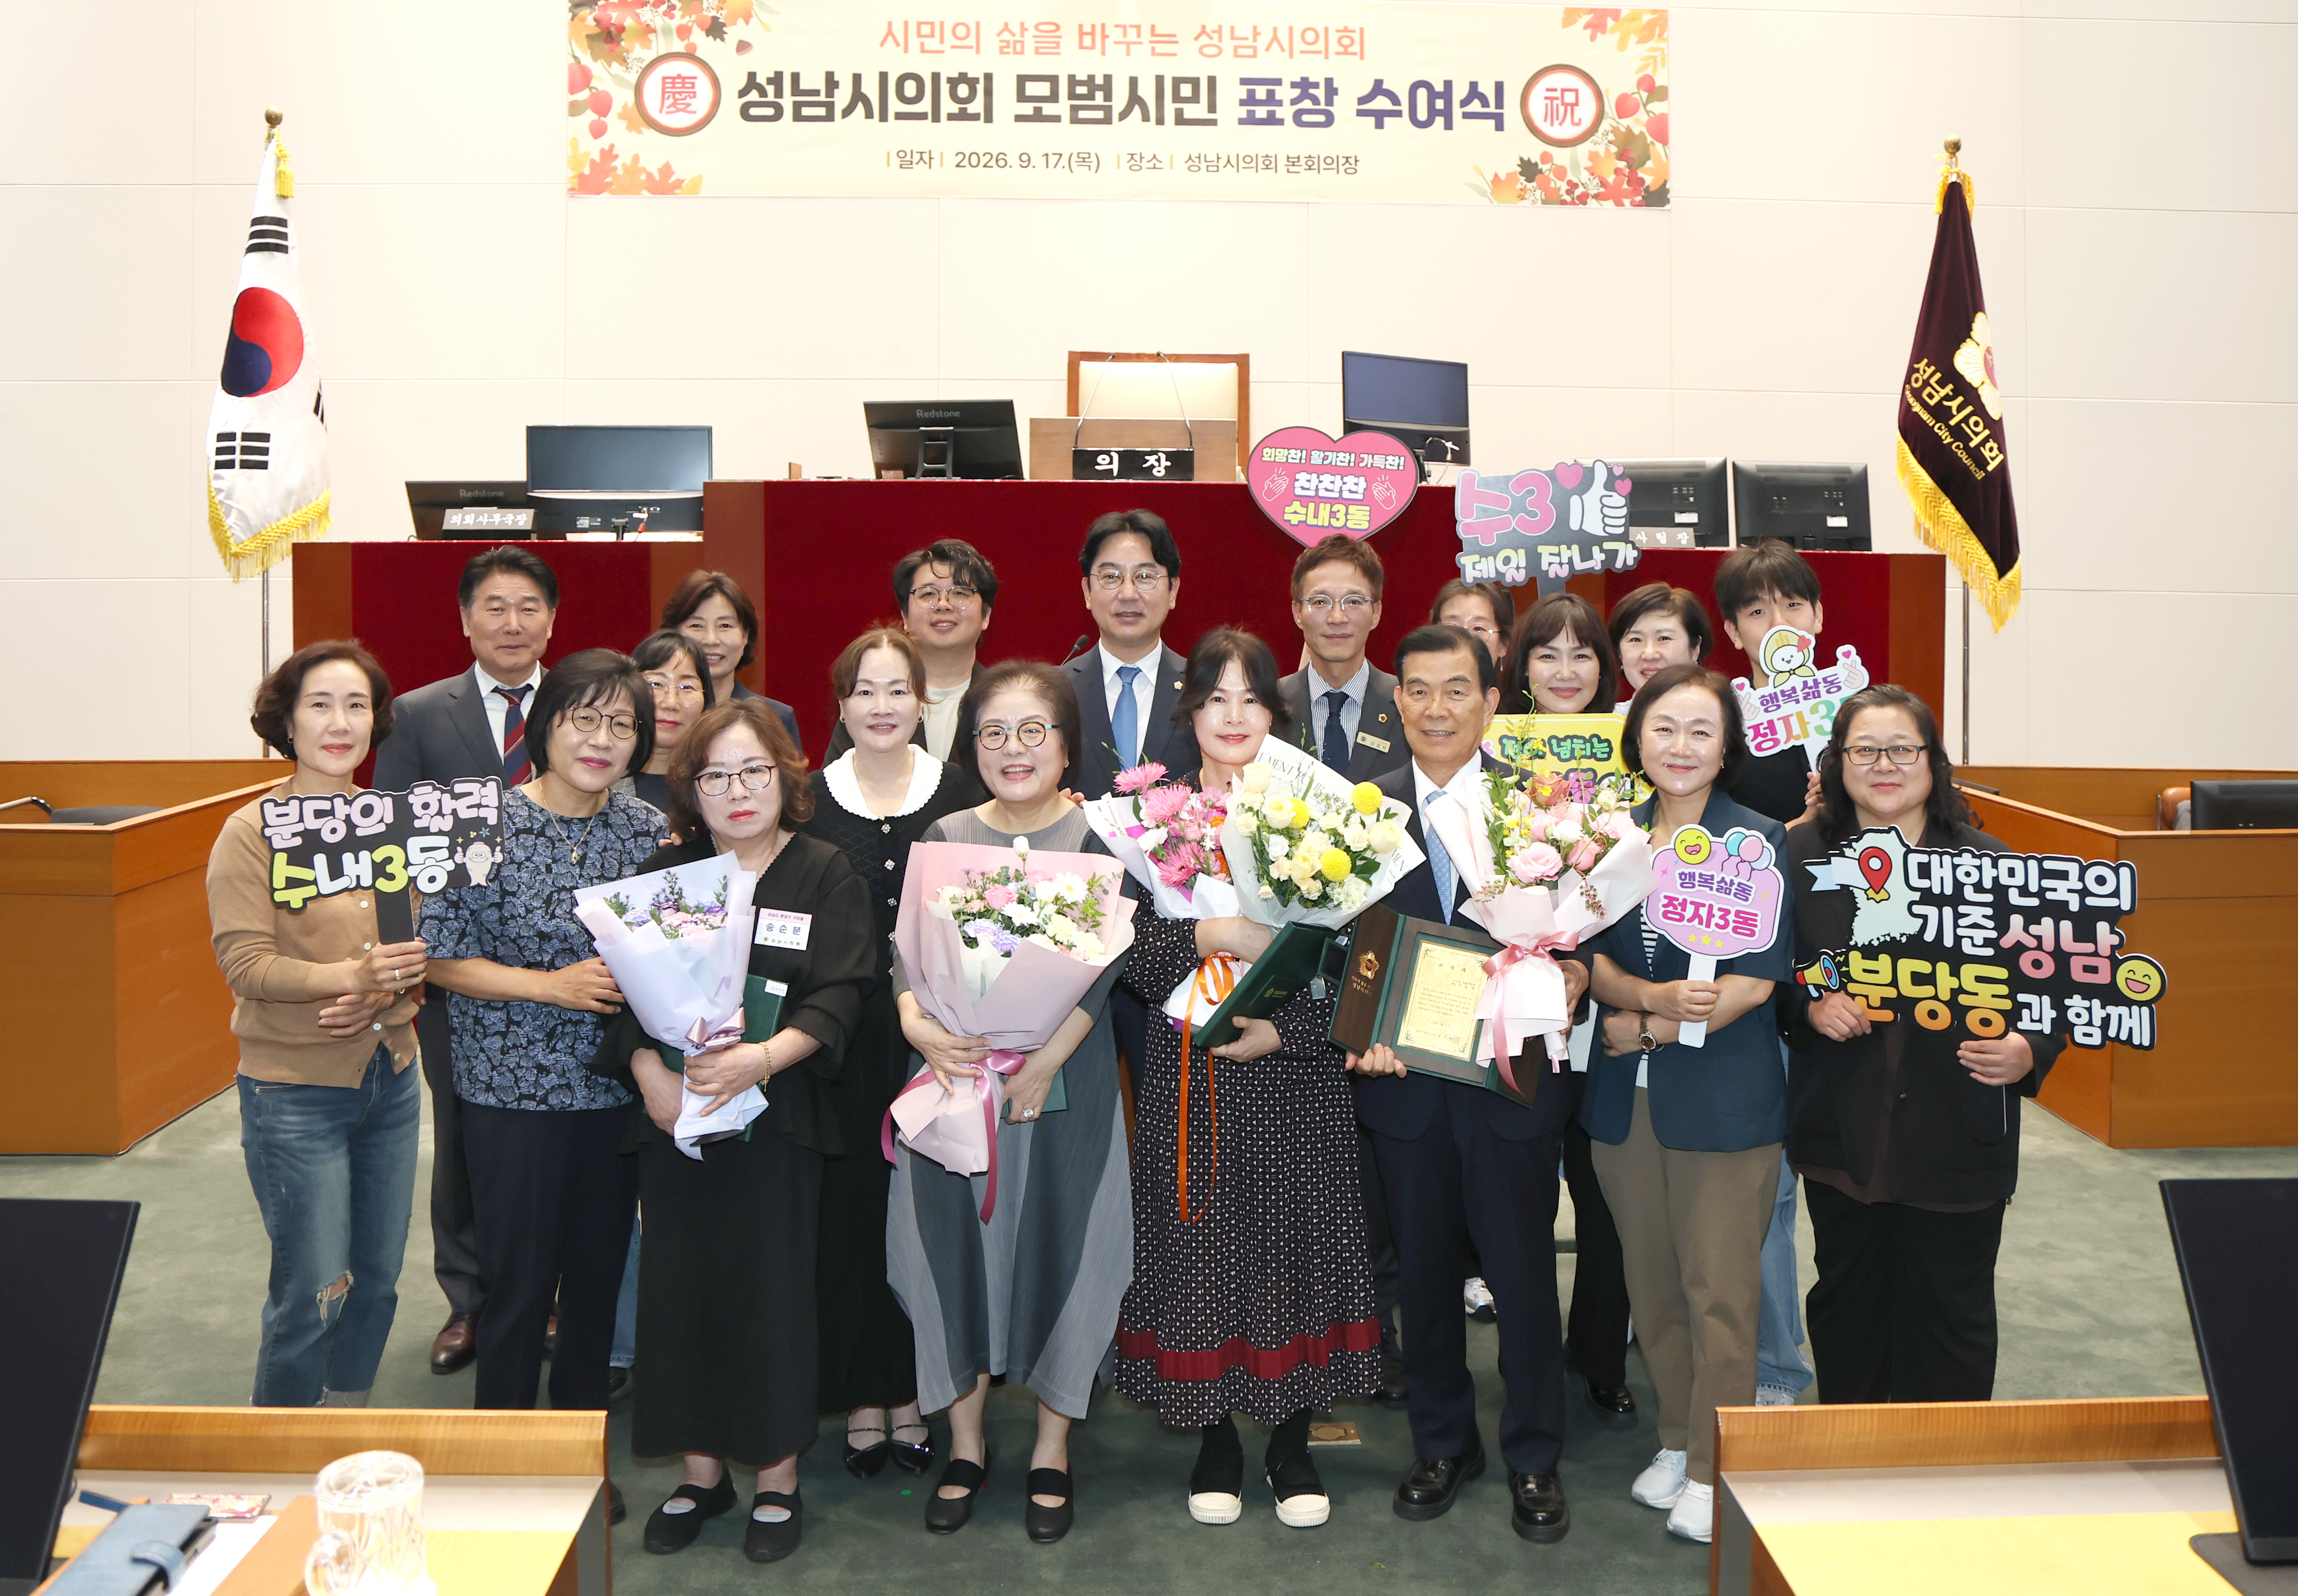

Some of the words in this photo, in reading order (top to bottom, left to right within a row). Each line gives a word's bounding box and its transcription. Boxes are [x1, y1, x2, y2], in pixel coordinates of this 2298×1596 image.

[879, 20, 980, 54] 시민의
[996, 21, 1062, 55] 삶을
[1078, 23, 1179, 56] 바꾸는
[1193, 24, 1364, 60] 성남시의회
[659, 73, 697, 114] 慶
[737, 70, 994, 124] 성남시의회
[1013, 74, 1218, 126] 모범시민
[1237, 76, 1339, 128] 표창
[1355, 79, 1505, 132] 수여식
[1543, 87, 1582, 127] 祝
[1184, 152, 1278, 173] 성남시의회
[1284, 154, 1360, 175] 본회의장
[916, 409, 961, 418] Redstone
[1910, 358, 2005, 472] 성남시의회
[1261, 446, 1307, 464] 희망찬!
[1310, 449, 1356, 467] 활기찬!
[1359, 452, 1405, 470] 가득찬!
[1934, 422, 1954, 445] City
[1951, 441, 1986, 481] Council
[459, 489, 504, 498] Redstone
[1294, 470, 1367, 500] 찬찬찬
[450, 513, 528, 526] 의회사무국장
[1283, 500, 1371, 530] 수내3동
[1460, 548, 1527, 583] 제일
[1537, 541, 1638, 579] 잘나가
[1758, 673, 1842, 713] 행복삶동
[1747, 696, 1850, 752] 정자3
[1550, 736, 1611, 760] 넘치는
[263, 793, 395, 849] 분당의
[407, 780, 500, 833] 활력
[272, 835, 456, 909] 수내3동
[1678, 871, 1754, 903] 행복삶동
[1906, 852, 2132, 913] 대한민국의
[1661, 894, 1759, 938] 정자3동
[2063, 994, 2152, 1047] 함께
